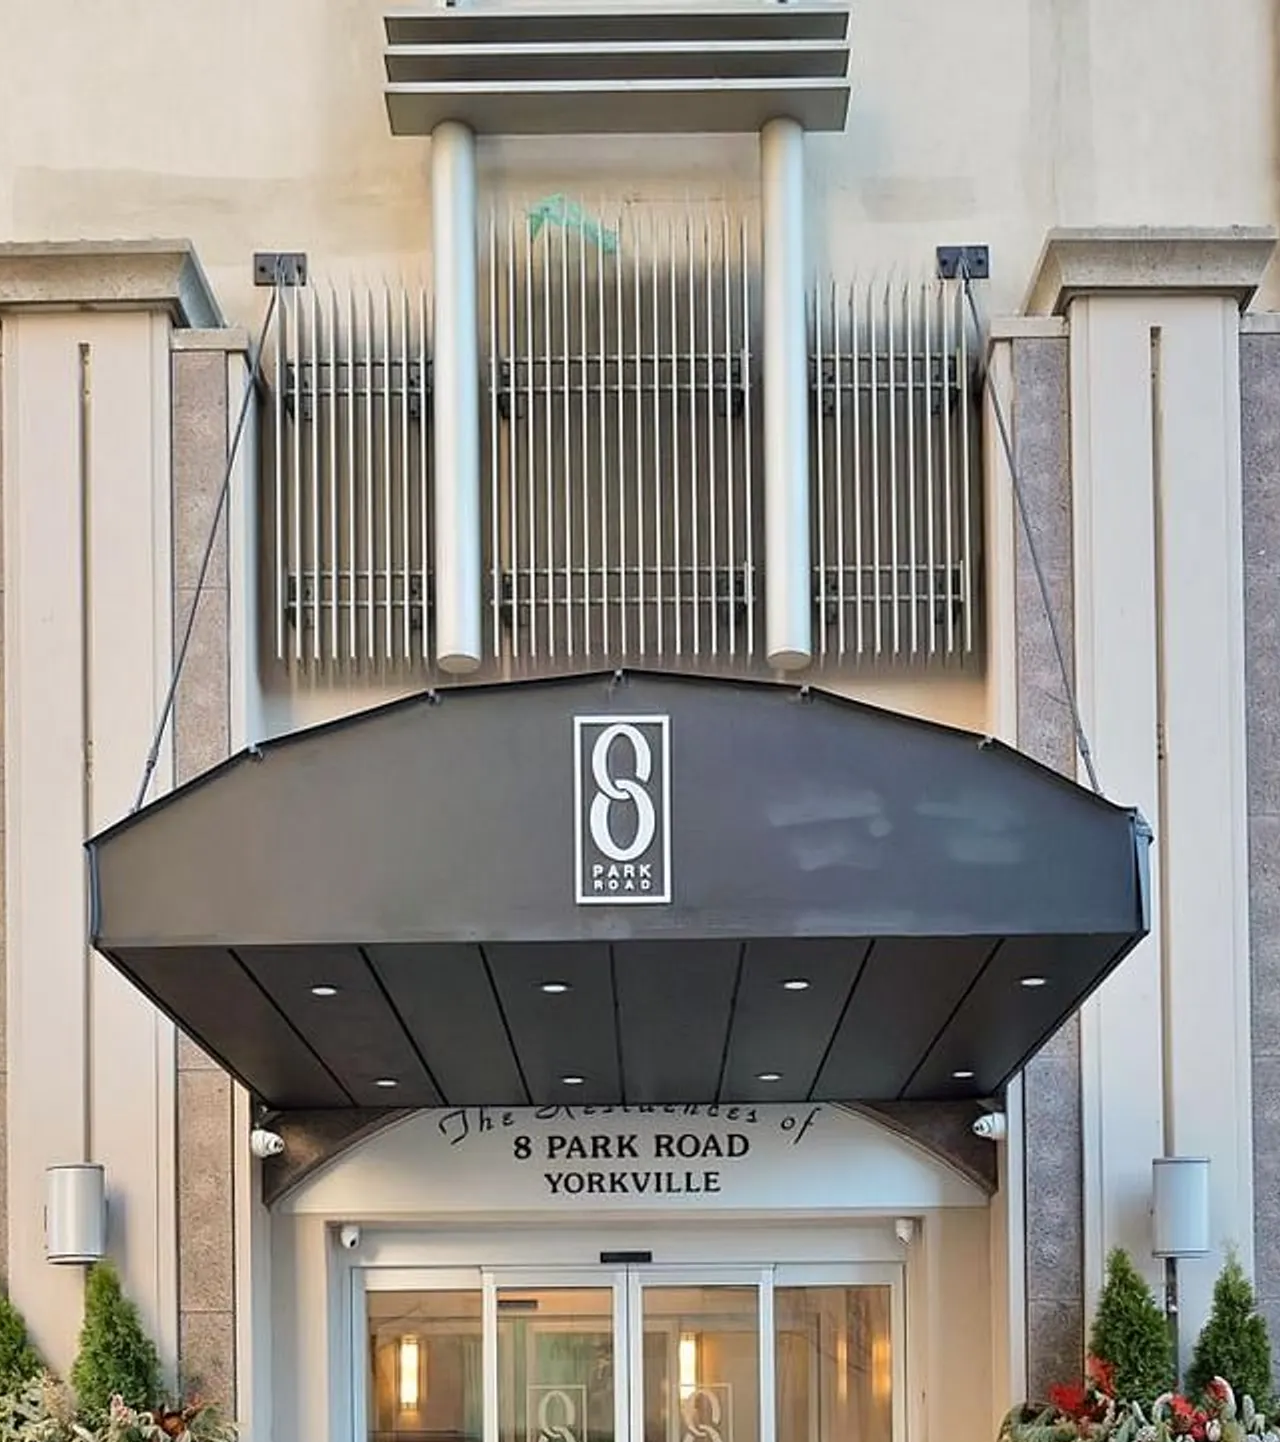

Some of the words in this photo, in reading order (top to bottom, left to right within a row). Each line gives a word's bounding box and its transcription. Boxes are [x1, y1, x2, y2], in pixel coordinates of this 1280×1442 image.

[593, 864, 651, 878] PARK
[593, 879, 651, 890] ROAD
[438, 1107, 514, 1146] The
[780, 1107, 822, 1145] of
[513, 1135, 532, 1159] 8
[547, 1135, 639, 1158] PARK
[654, 1134, 750, 1158] ROAD
[544, 1172, 721, 1194] YORKVILLE
